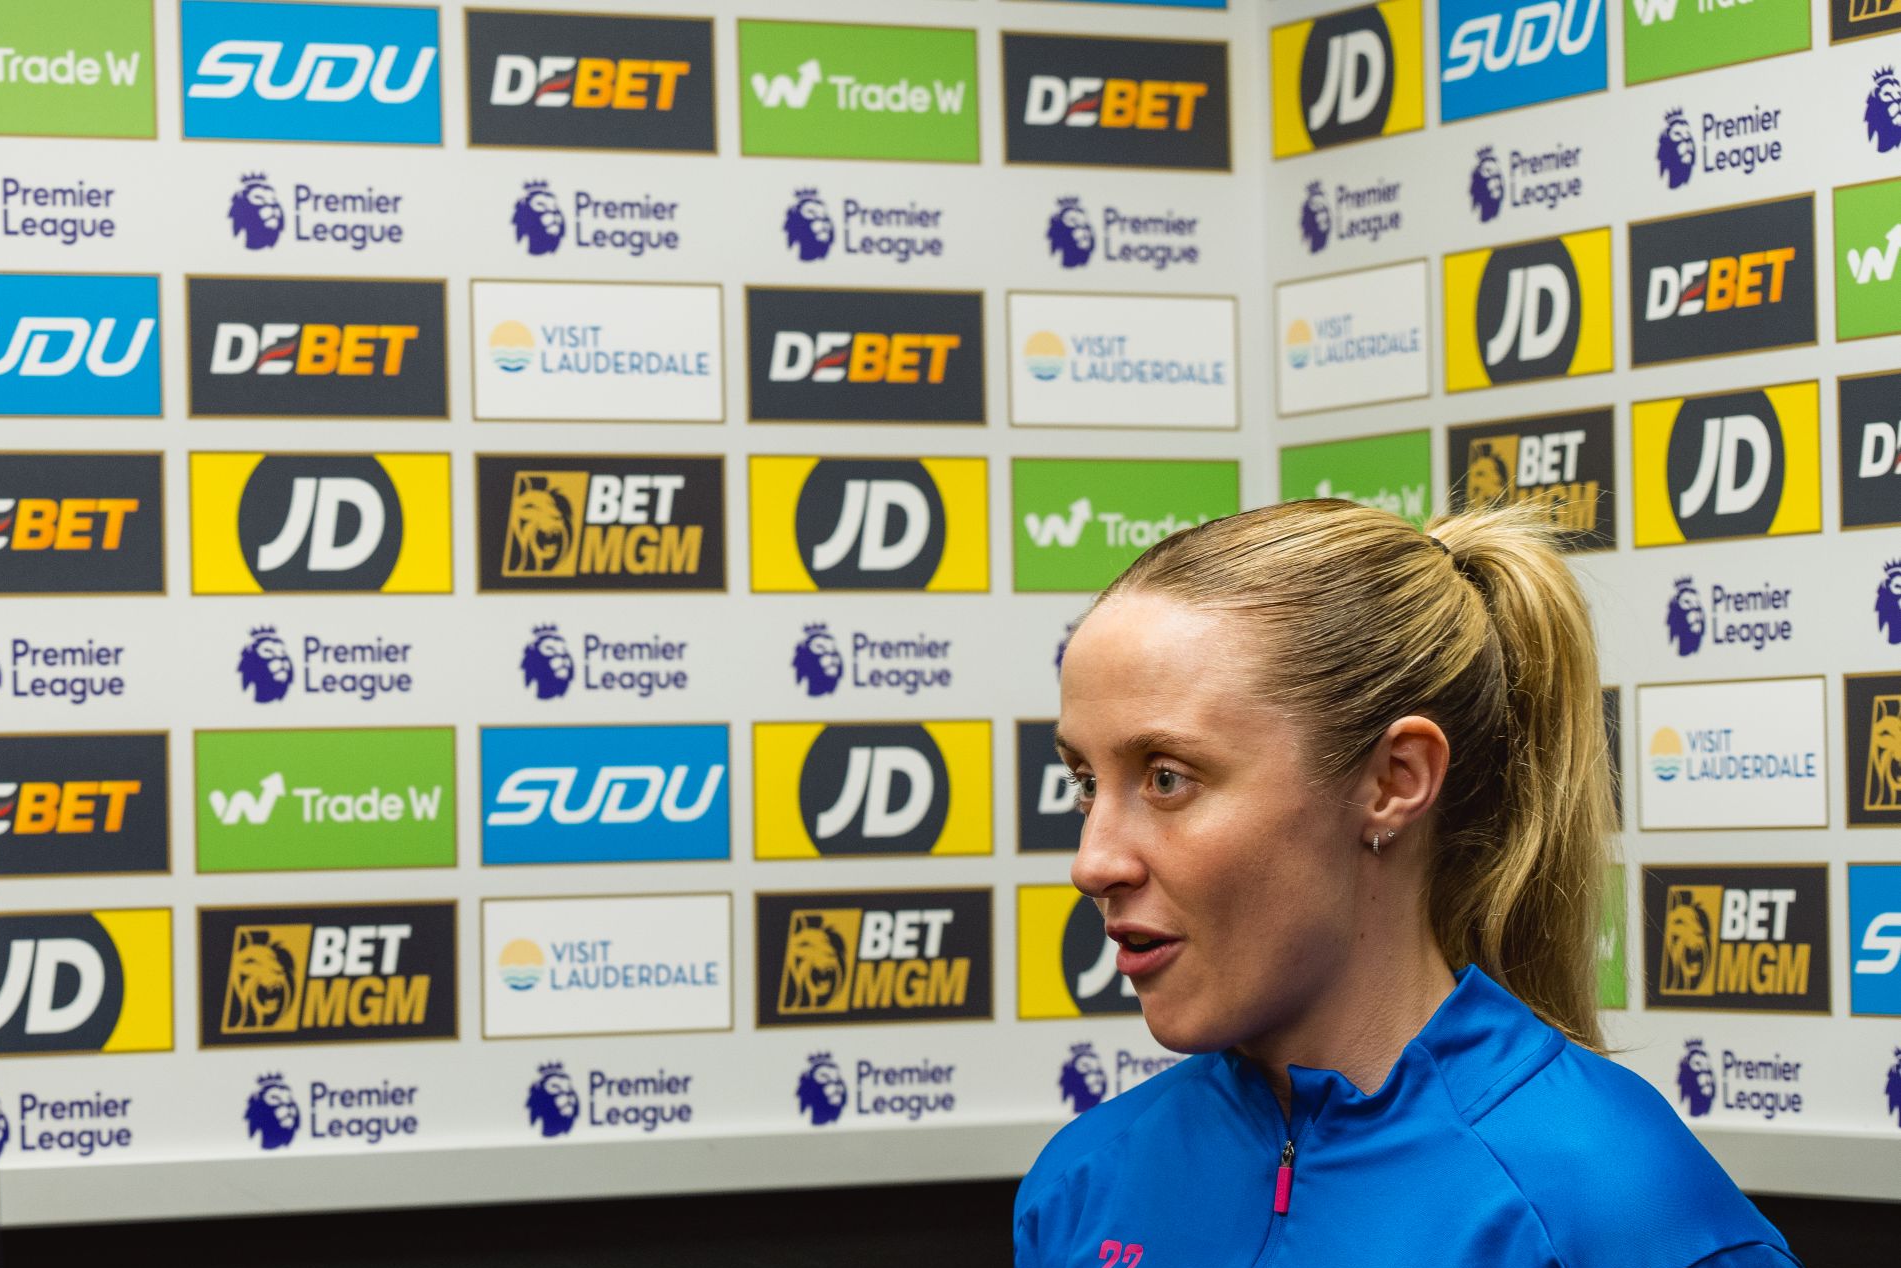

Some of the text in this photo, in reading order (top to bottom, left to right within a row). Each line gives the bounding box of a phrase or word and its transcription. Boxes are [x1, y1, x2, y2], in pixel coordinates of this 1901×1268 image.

[1441, 0, 1600, 83] SUDU
[105, 52, 140, 87] W
[187, 40, 437, 103] SUDU
[490, 55, 691, 111] DEBET
[1308, 29, 1386, 132] JD
[829, 75, 966, 115] Trade W
[1024, 75, 1208, 131] DEBET
[1703, 104, 1781, 142] Premier
[1510, 142, 1581, 177] Premier
[1703, 140, 1782, 175] League
[2, 177, 115, 208] Premier
[295, 184, 403, 214] Premier
[575, 191, 679, 222] Premier
[1335, 178, 1402, 209] Premier
[1510, 175, 1582, 210] League
[2, 209, 115, 245] League
[844, 199, 943, 229] Premier
[1104, 207, 1200, 237] Premier
[1335, 208, 1402, 244] League
[295, 214, 403, 251] League
[575, 221, 680, 257] League
[844, 228, 944, 263] League
[1104, 236, 1200, 271] League
[1645, 247, 1796, 321] DEBET
[1314, 314, 1353, 340] VISIT
[1487, 263, 1571, 367] JD
[210, 323, 419, 376] DEBET
[541, 325, 603, 349] VISIT
[1071, 335, 1128, 357] VISIT
[541, 350, 711, 376] LAUDERDALE
[769, 331, 960, 384] DEBET
[1071, 358, 1227, 386] LAUDERDALE
[1517, 430, 1585, 488] BET
[1679, 414, 1772, 519] JD
[587, 474, 684, 525] BET
[258, 477, 385, 571] JD
[813, 479, 930, 571] JD
[579, 525, 702, 575] MGM
[1712, 583, 1791, 611] Premier
[304, 637, 412, 664] Premier
[584, 634, 687, 661] Premier
[853, 632, 951, 659] Premier
[1712, 618, 1792, 650] League
[12, 639, 124, 667] Premier
[12, 671, 124, 703] League
[304, 667, 413, 700] League
[584, 665, 688, 697] League
[853, 661, 951, 695] League
[1686, 728, 1733, 753] VISIT
[1686, 753, 1816, 782] LAUDERDALE
[293, 785, 442, 824] Trade W
[488, 764, 725, 825] SUDU
[817, 746, 934, 838] JD
[1721, 889, 1796, 940] BET
[308, 924, 411, 978] BET
[859, 910, 953, 960] BET
[551, 941, 611, 965] VISIT
[1717, 943, 1811, 995] MGM
[551, 963, 718, 991] LAUDERDALE
[852, 958, 970, 1009] MGM
[301, 975, 430, 1028] MGM
[857, 1060, 954, 1089] Premier
[1722, 1049, 1801, 1082] Premier
[311, 1080, 418, 1109] Premier
[590, 1070, 692, 1099] Premier
[1722, 1083, 1803, 1120] League
[21, 1093, 132, 1121] Premier
[590, 1099, 692, 1132] League
[857, 1089, 954, 1120] League
[21, 1123, 132, 1157] League
[311, 1110, 418, 1144] League
